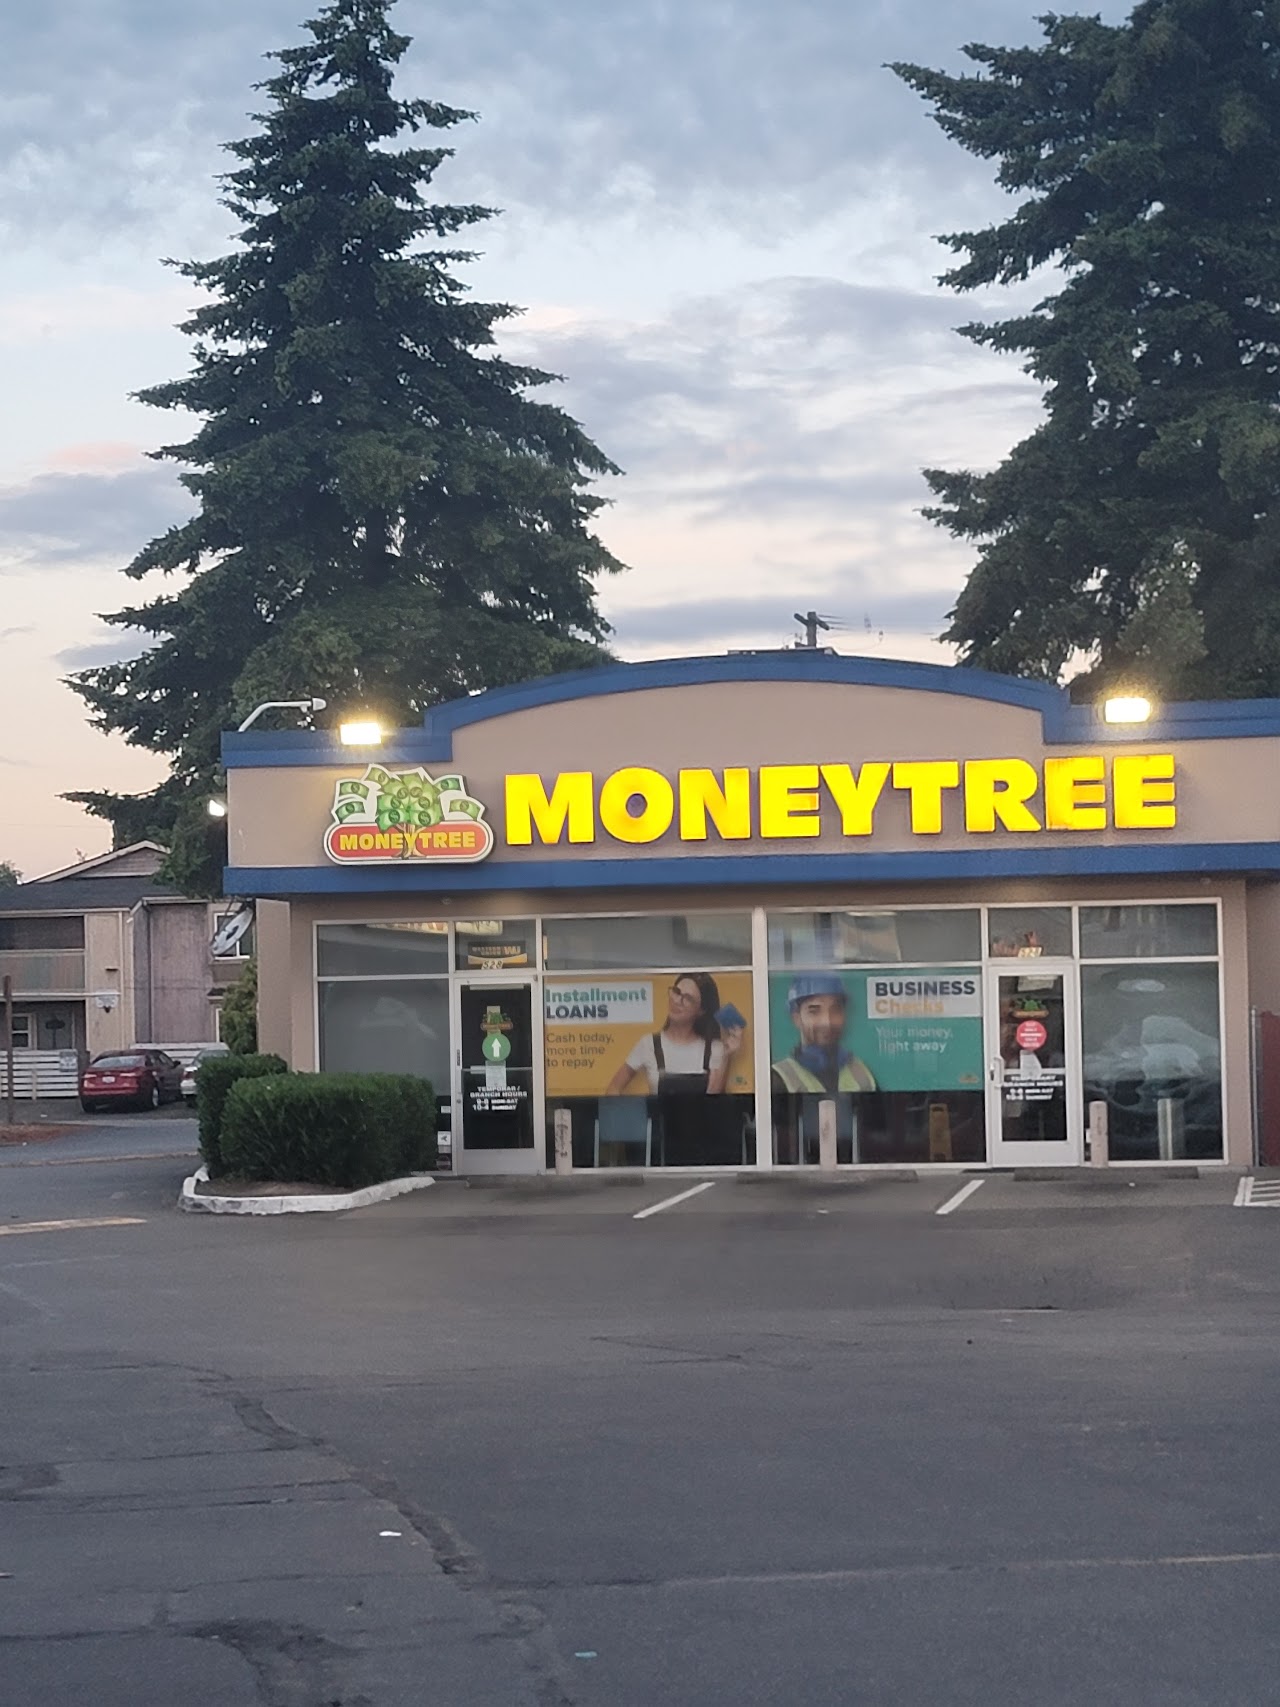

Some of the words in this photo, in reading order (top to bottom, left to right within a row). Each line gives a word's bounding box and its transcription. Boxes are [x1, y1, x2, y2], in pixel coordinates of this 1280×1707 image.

[504, 754, 1177, 845] MONEYTREE
[339, 831, 476, 850] MONEYTREE
[545, 987, 647, 1003] Installment
[875, 980, 976, 997] BUSINESS
[546, 1004, 609, 1019] LOANS
[547, 1032, 576, 1043] Cash
[546, 1045, 577, 1055] more
[579, 1044, 606, 1055] time
[913, 1041, 947, 1053] away
[546, 1058, 559, 1067] to
[562, 1058, 595, 1069] repay
